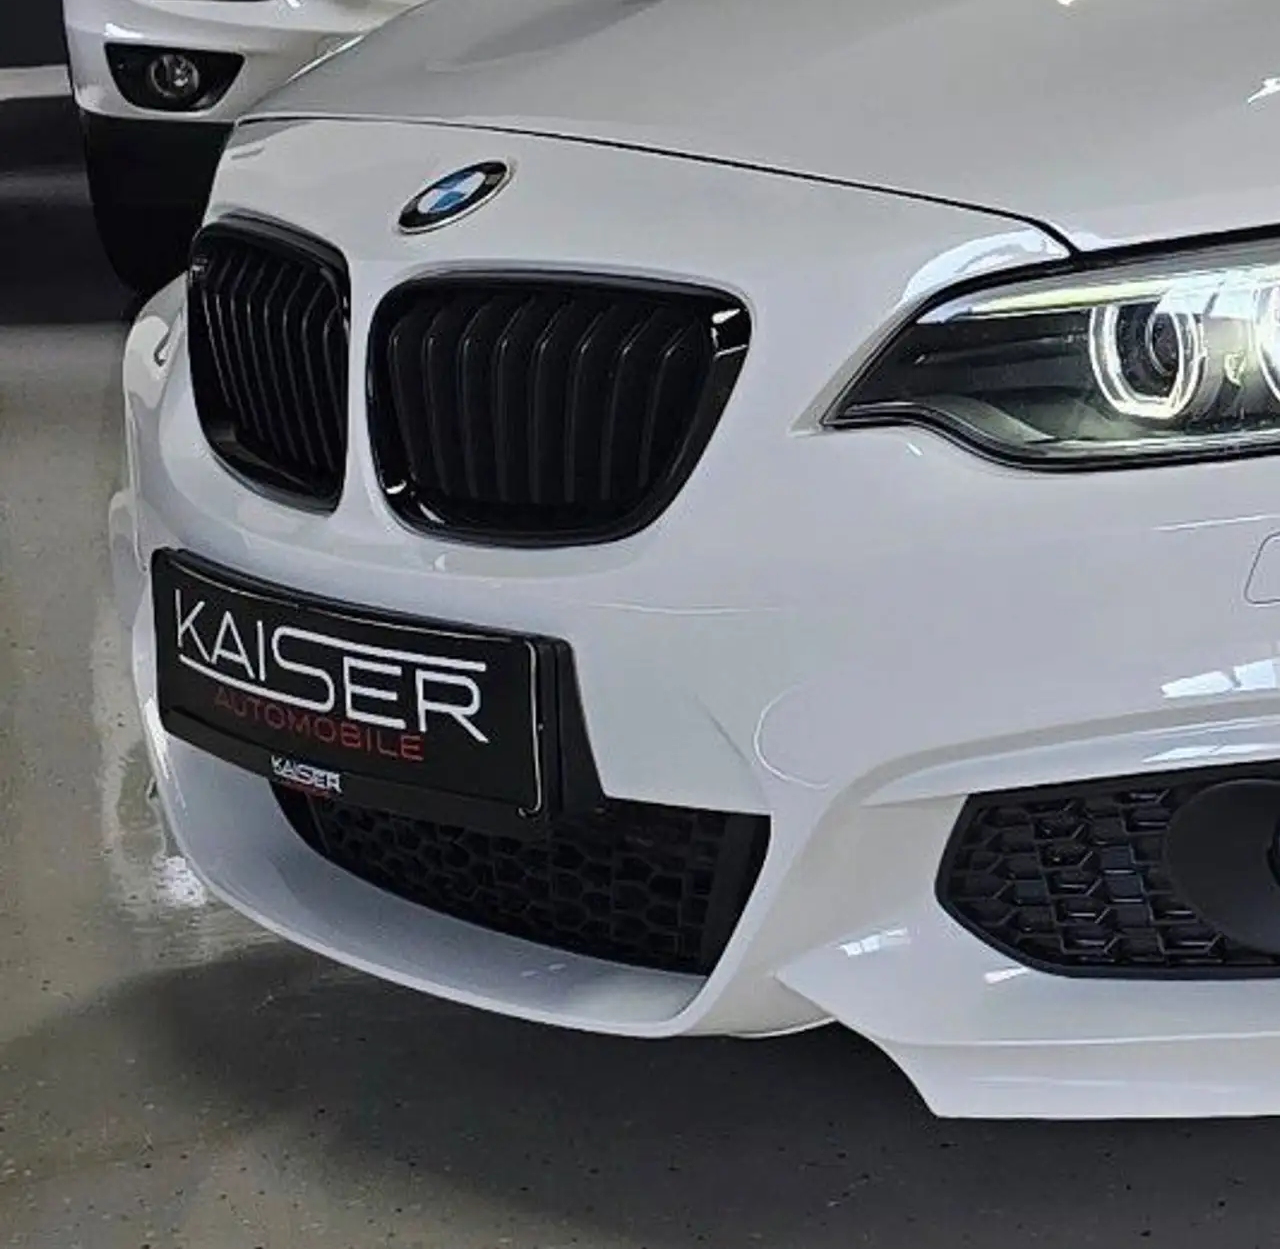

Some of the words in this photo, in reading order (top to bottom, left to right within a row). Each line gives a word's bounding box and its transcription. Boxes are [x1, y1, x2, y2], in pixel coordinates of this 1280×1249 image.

[175, 589, 489, 744] KAISER
[214, 686, 425, 762] AUTOMOBILE
[271, 755, 342, 793] KAISER
